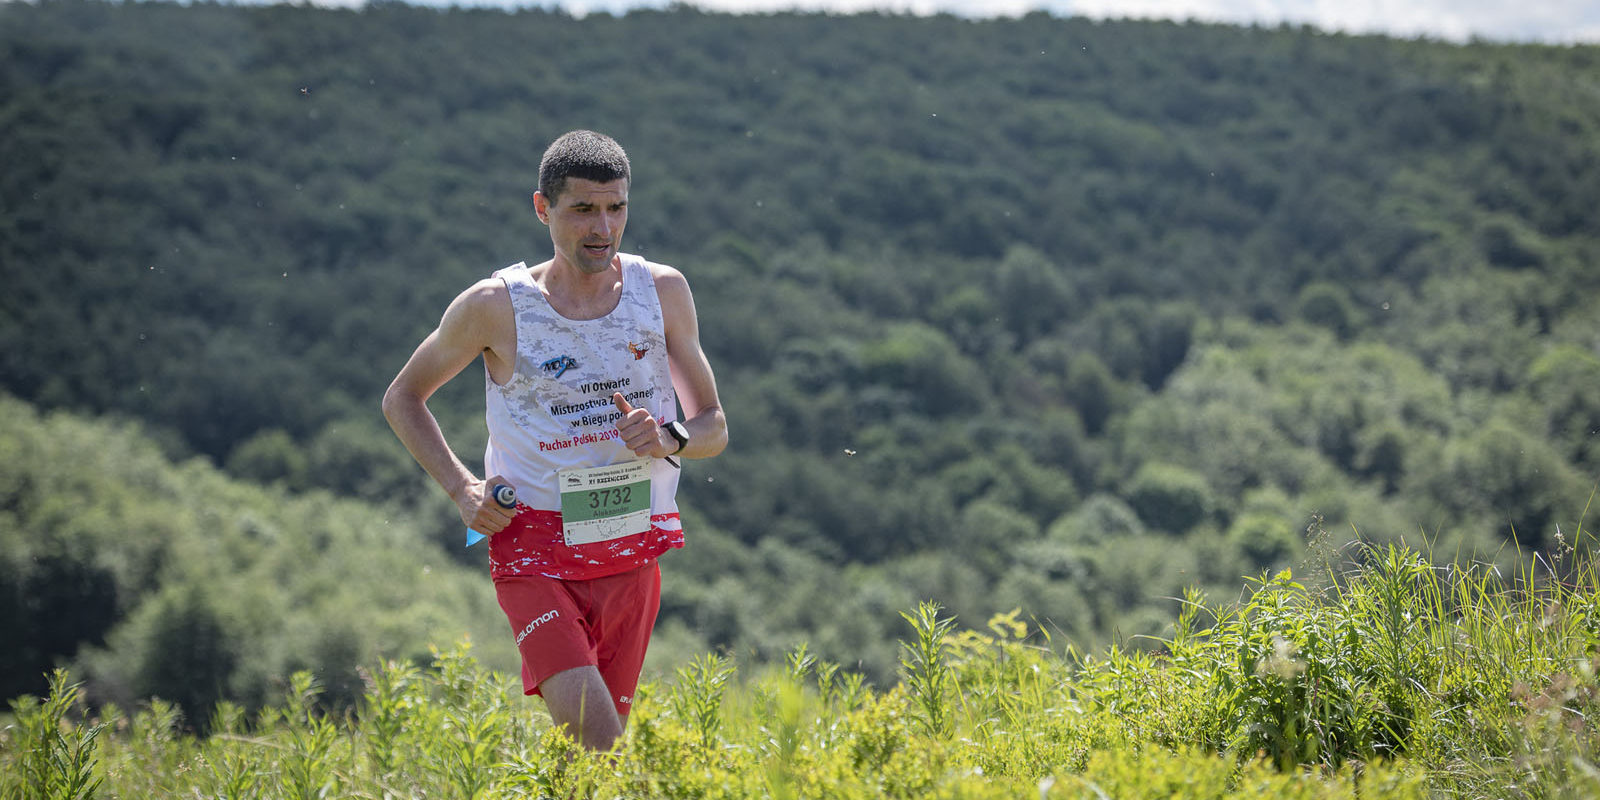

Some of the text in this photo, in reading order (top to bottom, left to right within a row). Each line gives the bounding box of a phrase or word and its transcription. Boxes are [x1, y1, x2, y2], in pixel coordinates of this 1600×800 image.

[580, 377, 630, 394] VI Otwarte
[550, 397, 608, 416] Mistrzostwa
[571, 420, 580, 428] w
[582, 413, 607, 426] Biegu
[539, 429, 619, 452] Puchar Polski 2019
[588, 486, 632, 509] 3732
